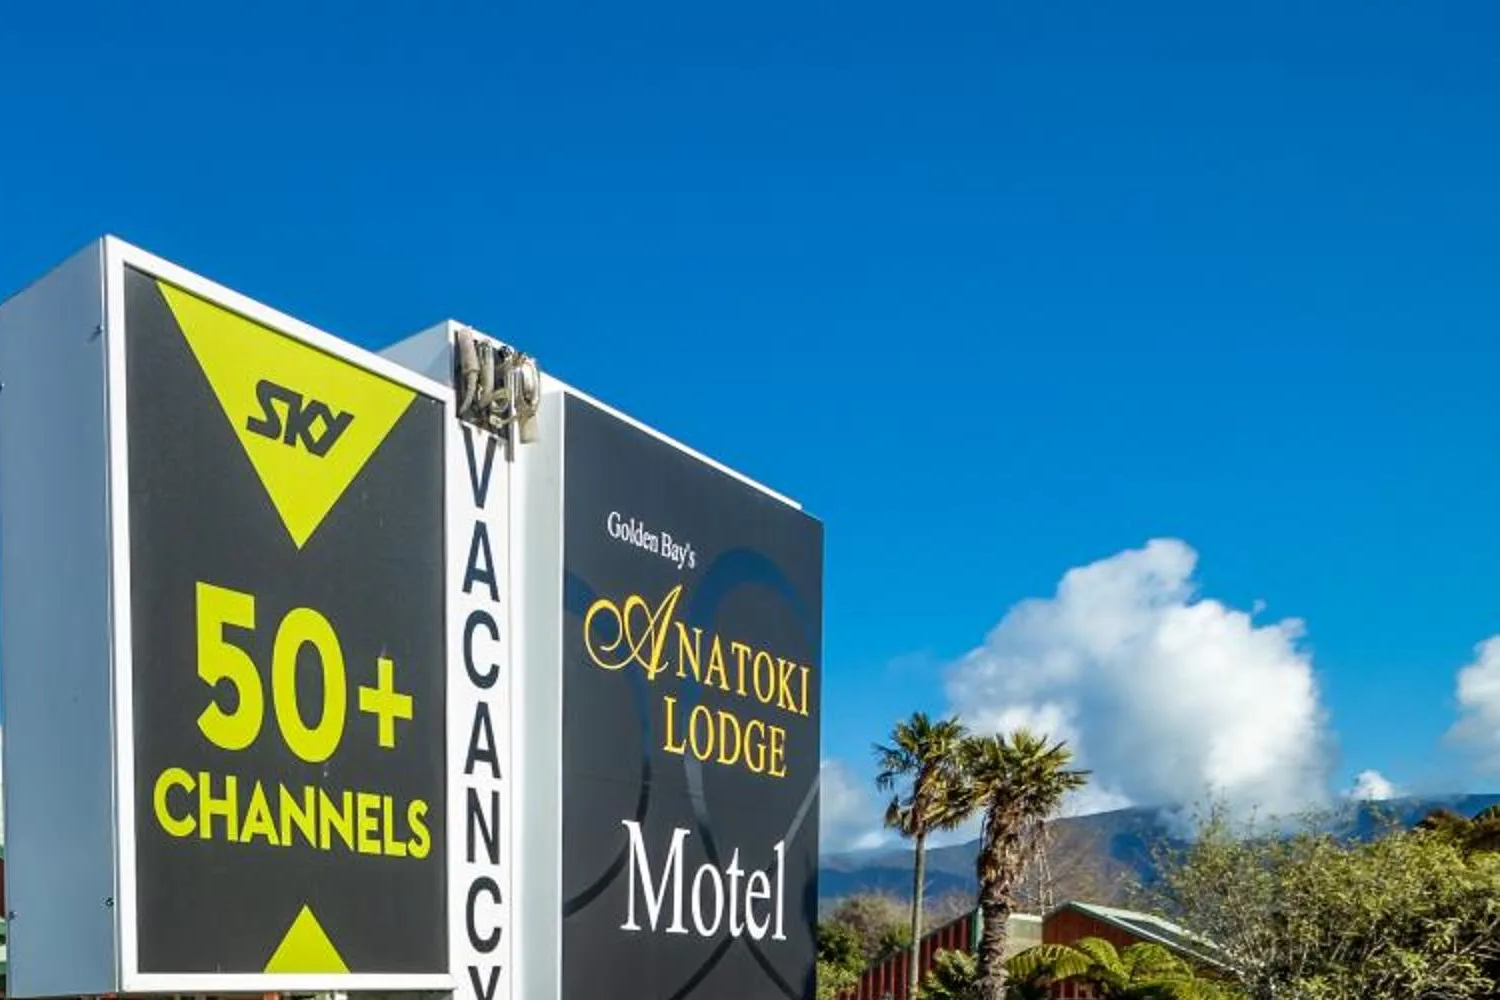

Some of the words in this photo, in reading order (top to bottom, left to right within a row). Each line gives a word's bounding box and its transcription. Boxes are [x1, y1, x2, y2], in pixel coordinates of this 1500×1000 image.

[246, 379, 355, 458] SKY
[607, 511, 658, 553] Golden
[661, 531, 696, 570] Bay's
[196, 581, 414, 762] 50+
[583, 584, 810, 717] ANATOKI
[663, 695, 788, 778] LODGE
[153, 765, 432, 860] CHANNELS
[620, 819, 787, 941] Motel
